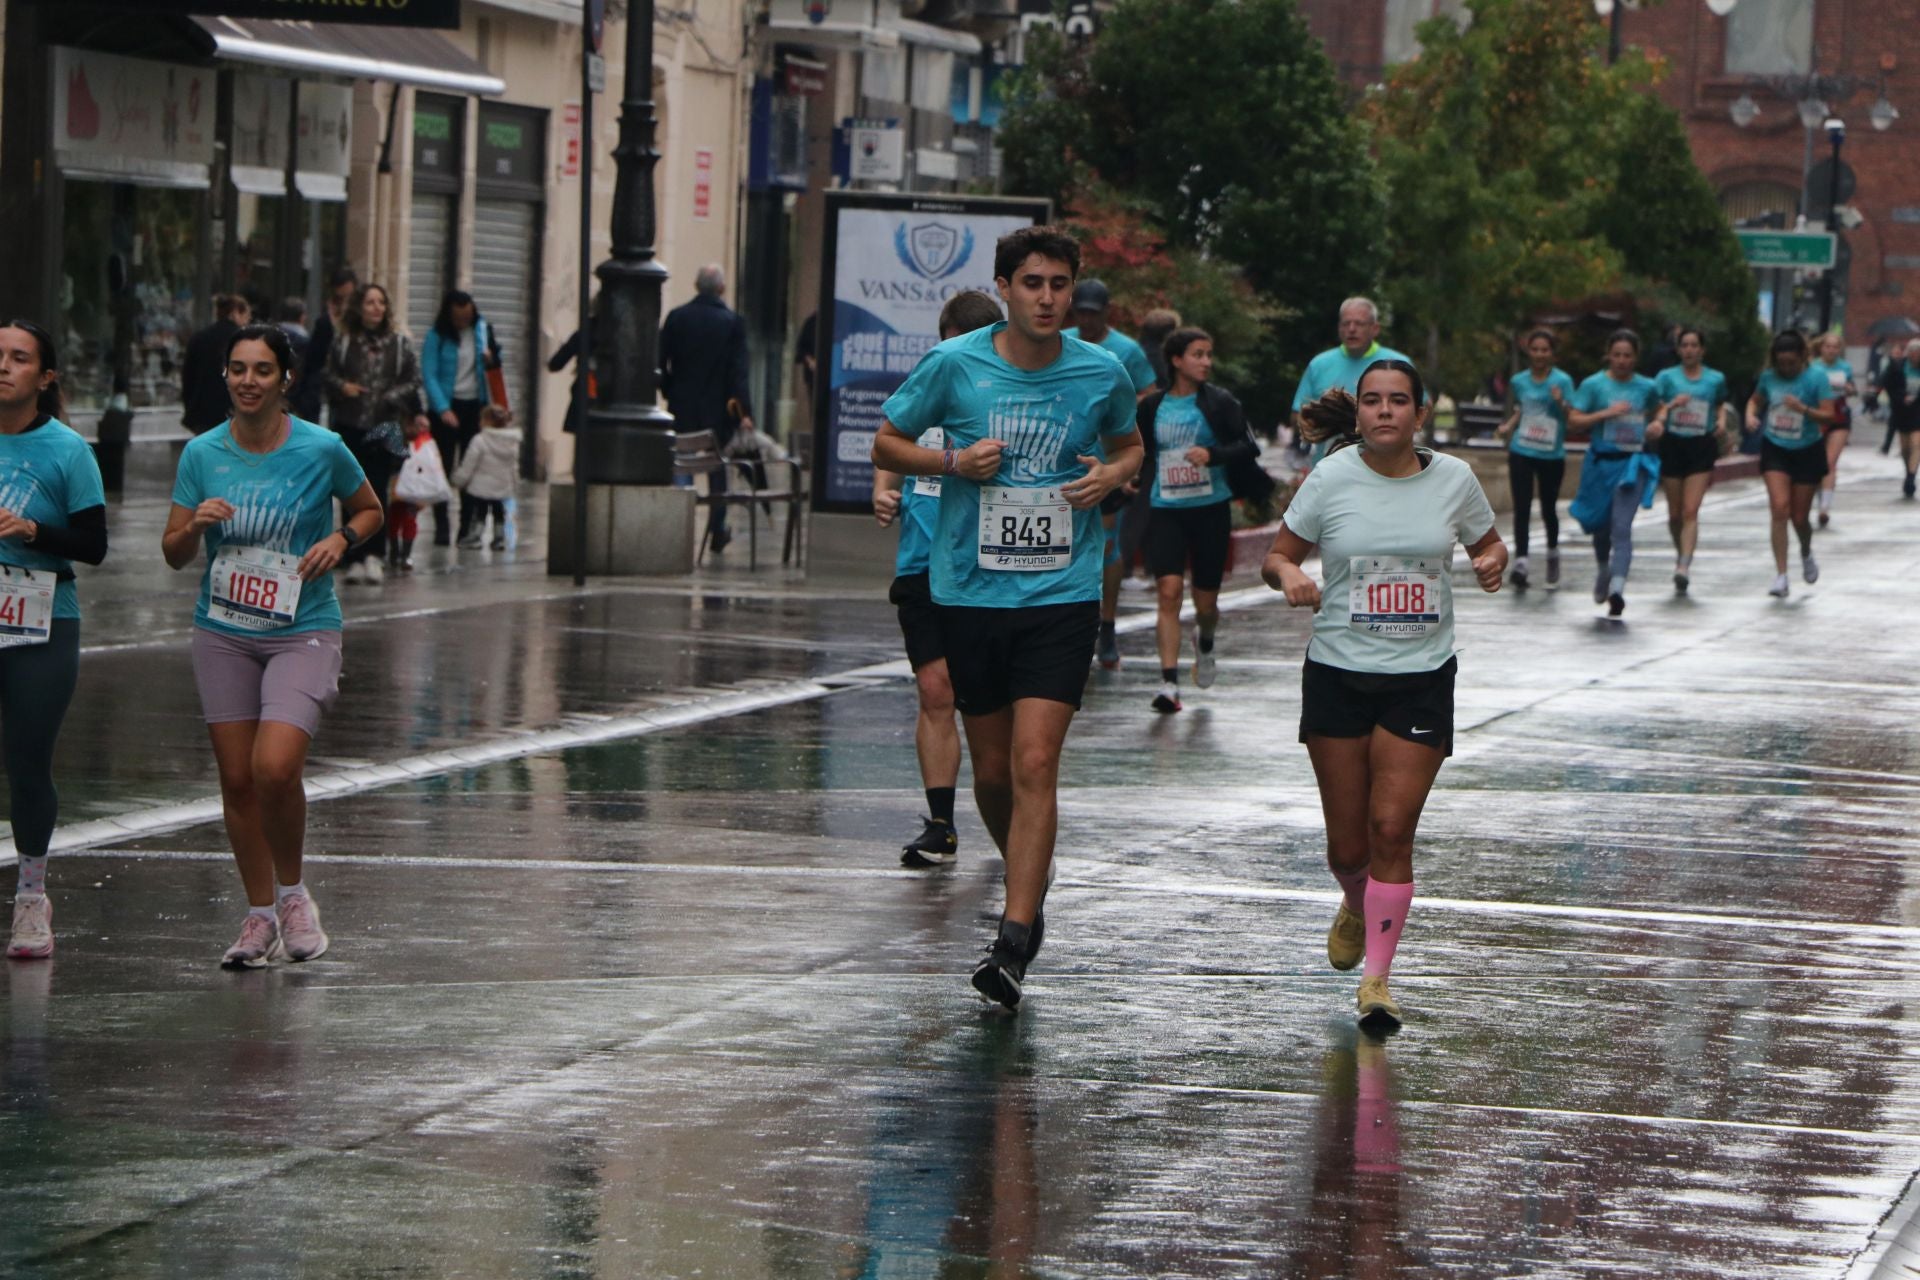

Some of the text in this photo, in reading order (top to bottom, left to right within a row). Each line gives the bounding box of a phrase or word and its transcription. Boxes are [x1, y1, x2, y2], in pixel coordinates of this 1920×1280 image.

[843, 331, 938, 354] ¿QUÉ NECES
[842, 353, 884, 371] PARA
[840, 401, 883, 414] Turismo
[838, 415, 883, 427] Monovol
[1167, 466, 1200, 485] 1036
[1001, 516, 1051, 546] 843
[1014, 556, 1056, 564] HYUNDAI
[229, 571, 279, 610] 1168
[1367, 583, 1425, 613] 1008
[238, 613, 278, 628] HYUNDAI
[1386, 624, 1426, 632] HYUNDAI
[0, 635, 32, 645] UNDAI
